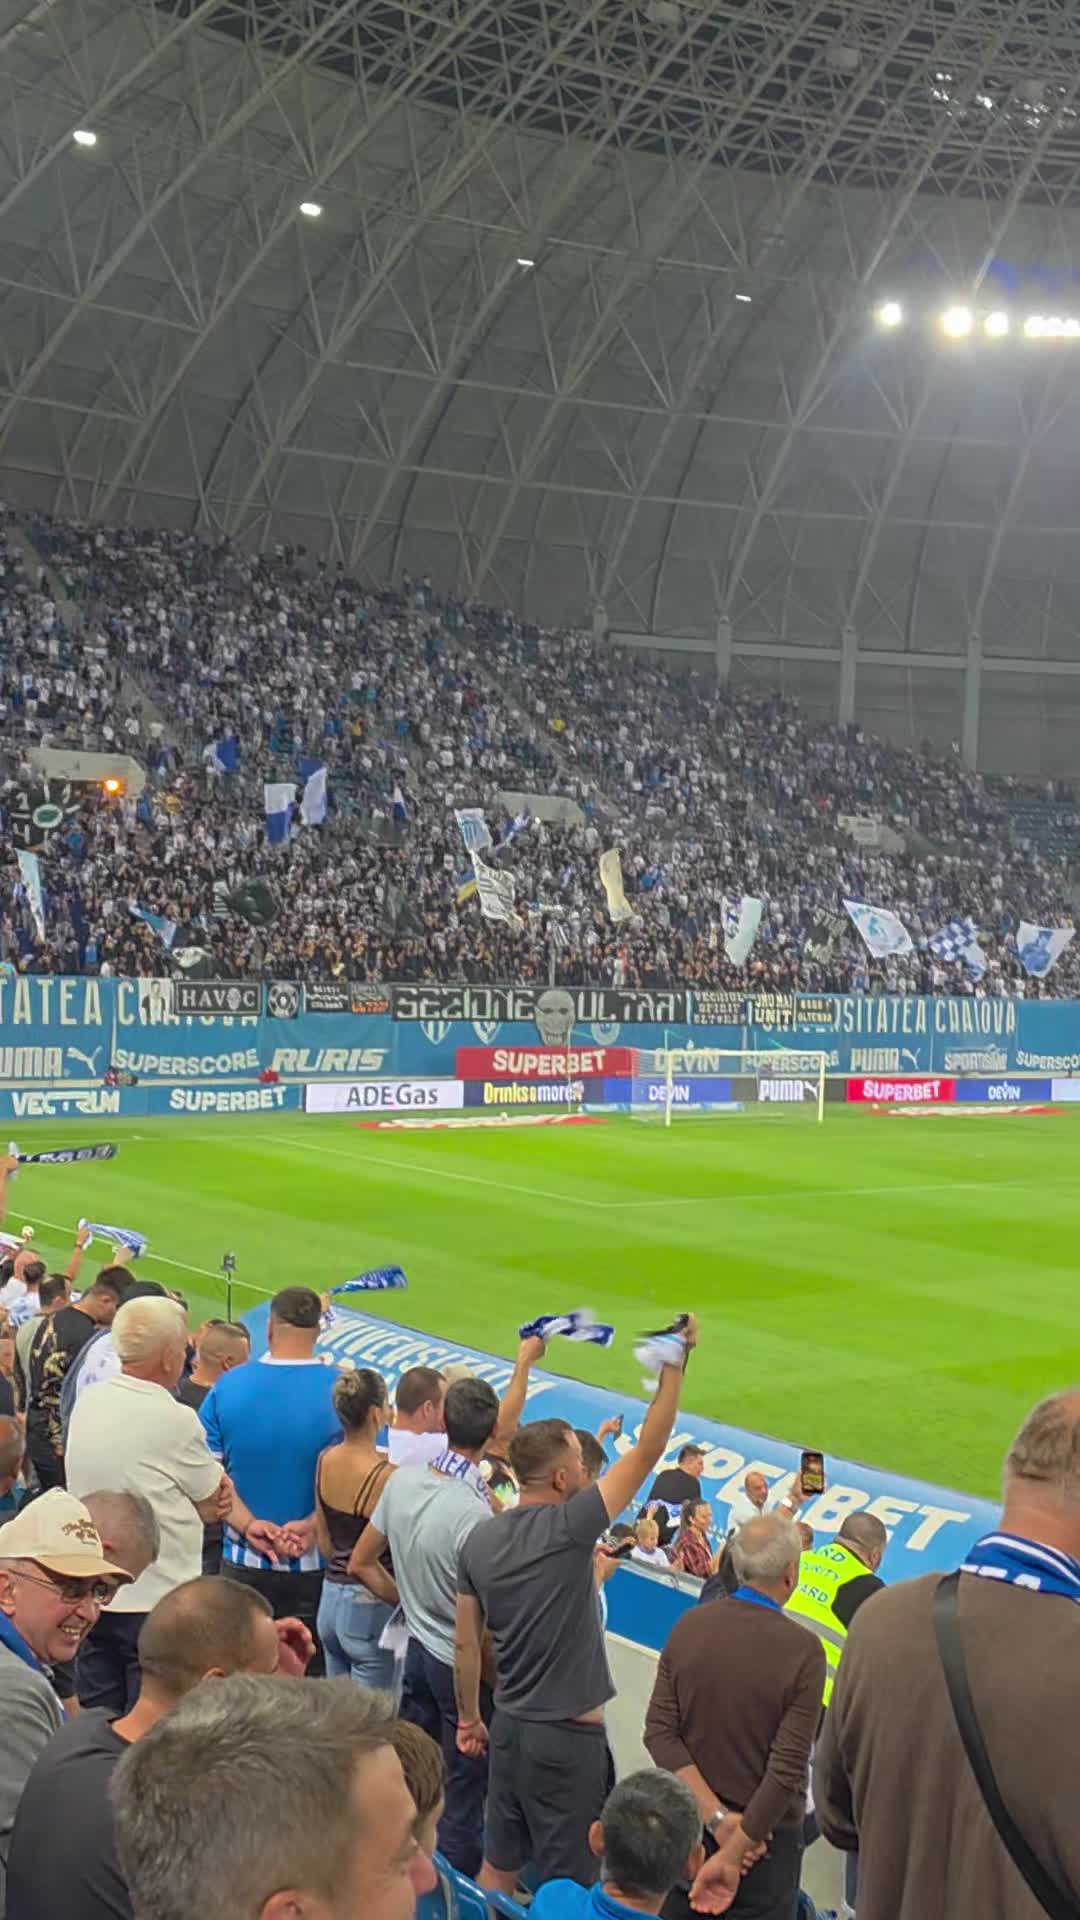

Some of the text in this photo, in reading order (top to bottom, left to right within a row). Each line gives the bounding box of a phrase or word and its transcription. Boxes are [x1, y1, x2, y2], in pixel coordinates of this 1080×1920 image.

[112, 1049, 260, 1075] SUPERSCORE
[272, 1048, 390, 1072] RURIS
[493, 1049, 606, 1075] SUPERBET
[851, 1048, 899, 1072] PUMA
[169, 1086, 287, 1112] SUPERBET
[347, 1083, 438, 1107] ADEGas
[649, 1084, 690, 1101] DEVIN
[759, 1079, 804, 1101] PUMA
[863, 1080, 940, 1101] SUPERBET
[988, 1080, 1020, 1100] DEVIN
[800, 1583, 829, 1603] ARD
